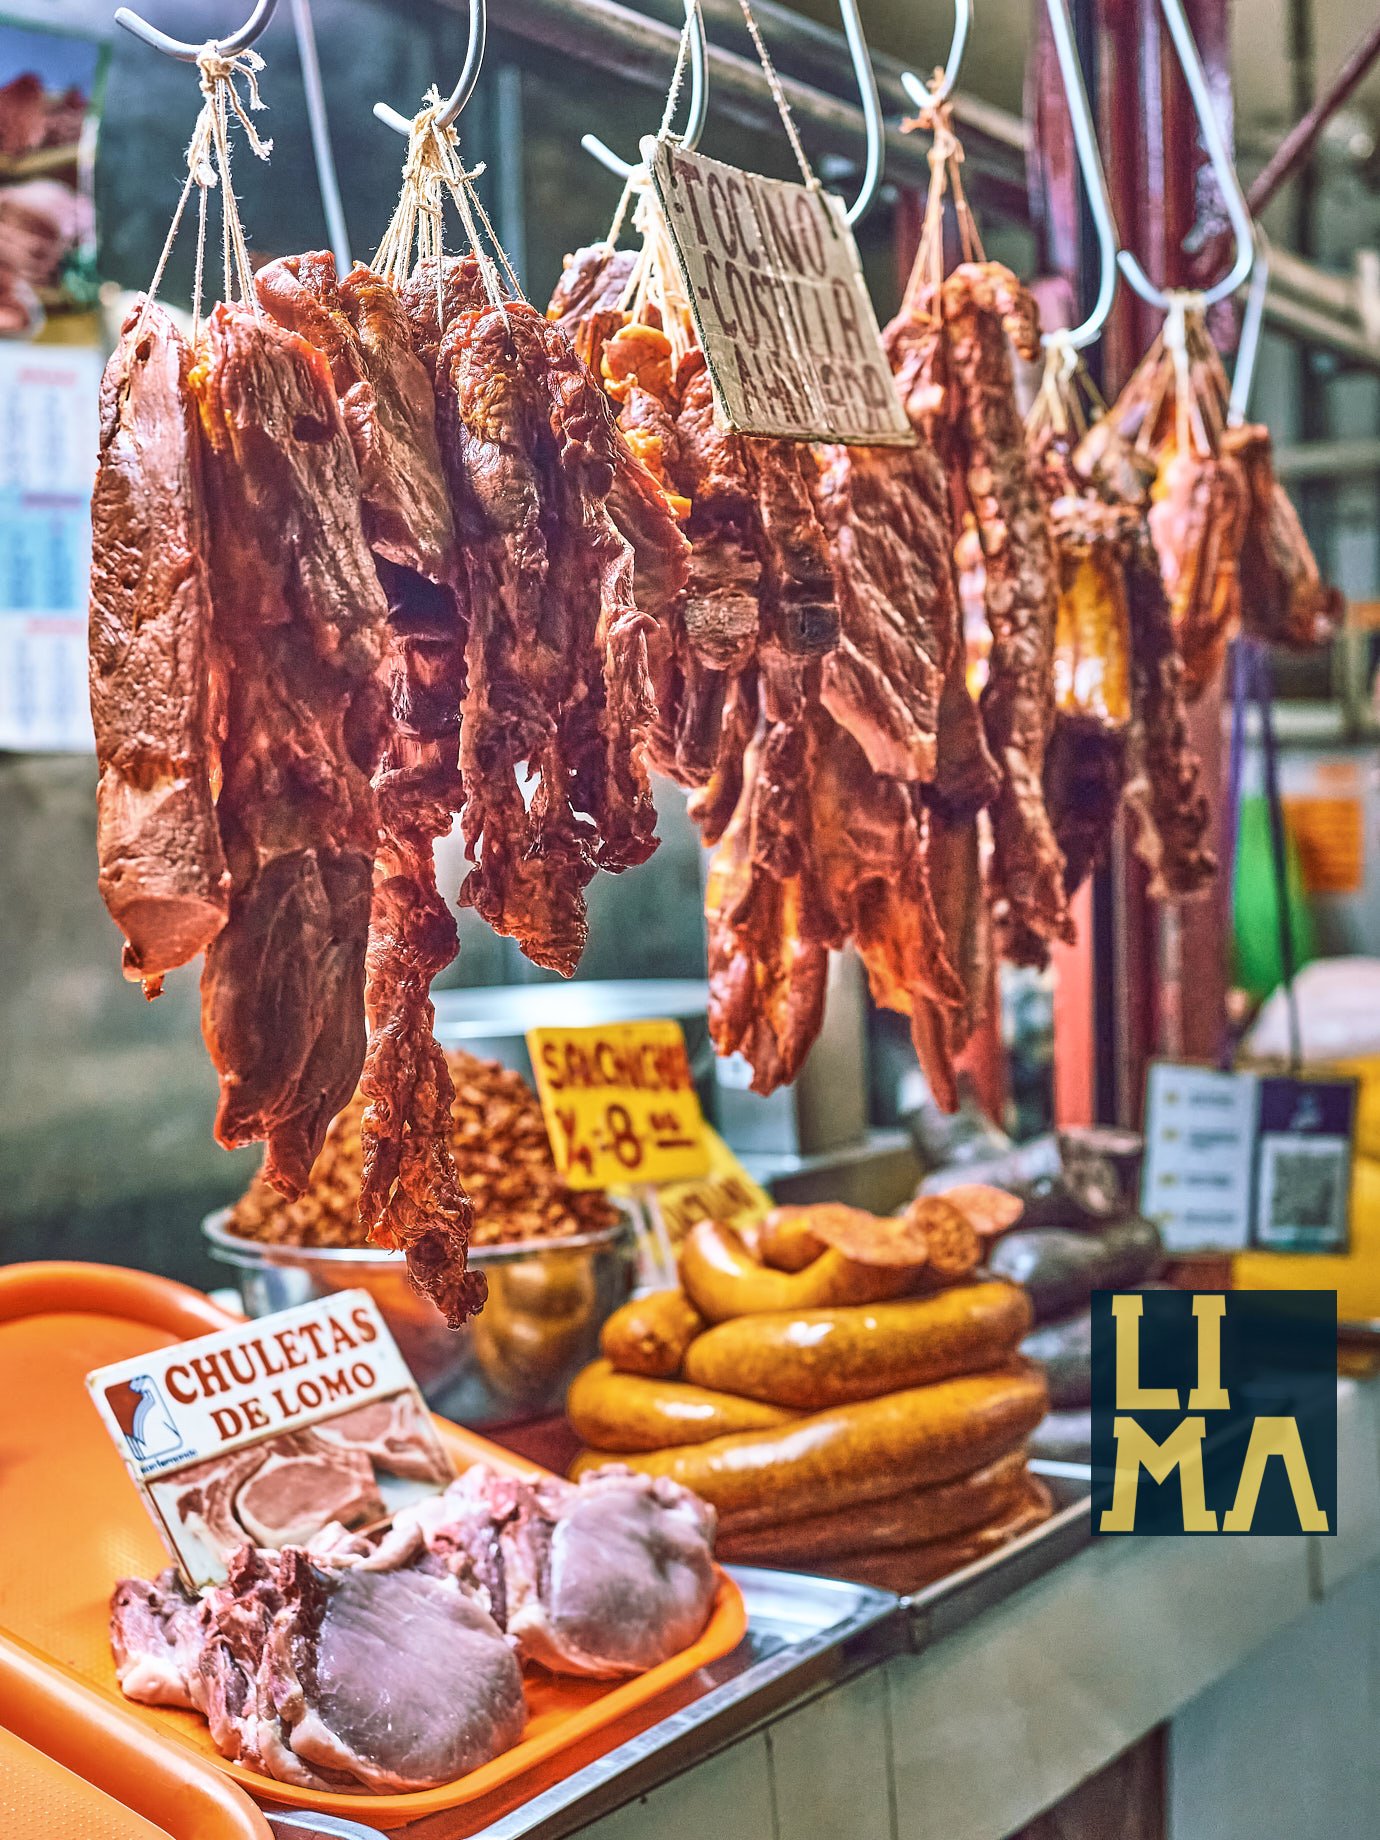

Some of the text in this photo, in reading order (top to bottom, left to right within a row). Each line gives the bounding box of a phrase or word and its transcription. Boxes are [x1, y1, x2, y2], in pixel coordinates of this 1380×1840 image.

[674, 159, 827, 279] TOCINO
[164, 1307, 378, 1405] CHULETAS
[209, 1361, 377, 1441] DE LOMO
